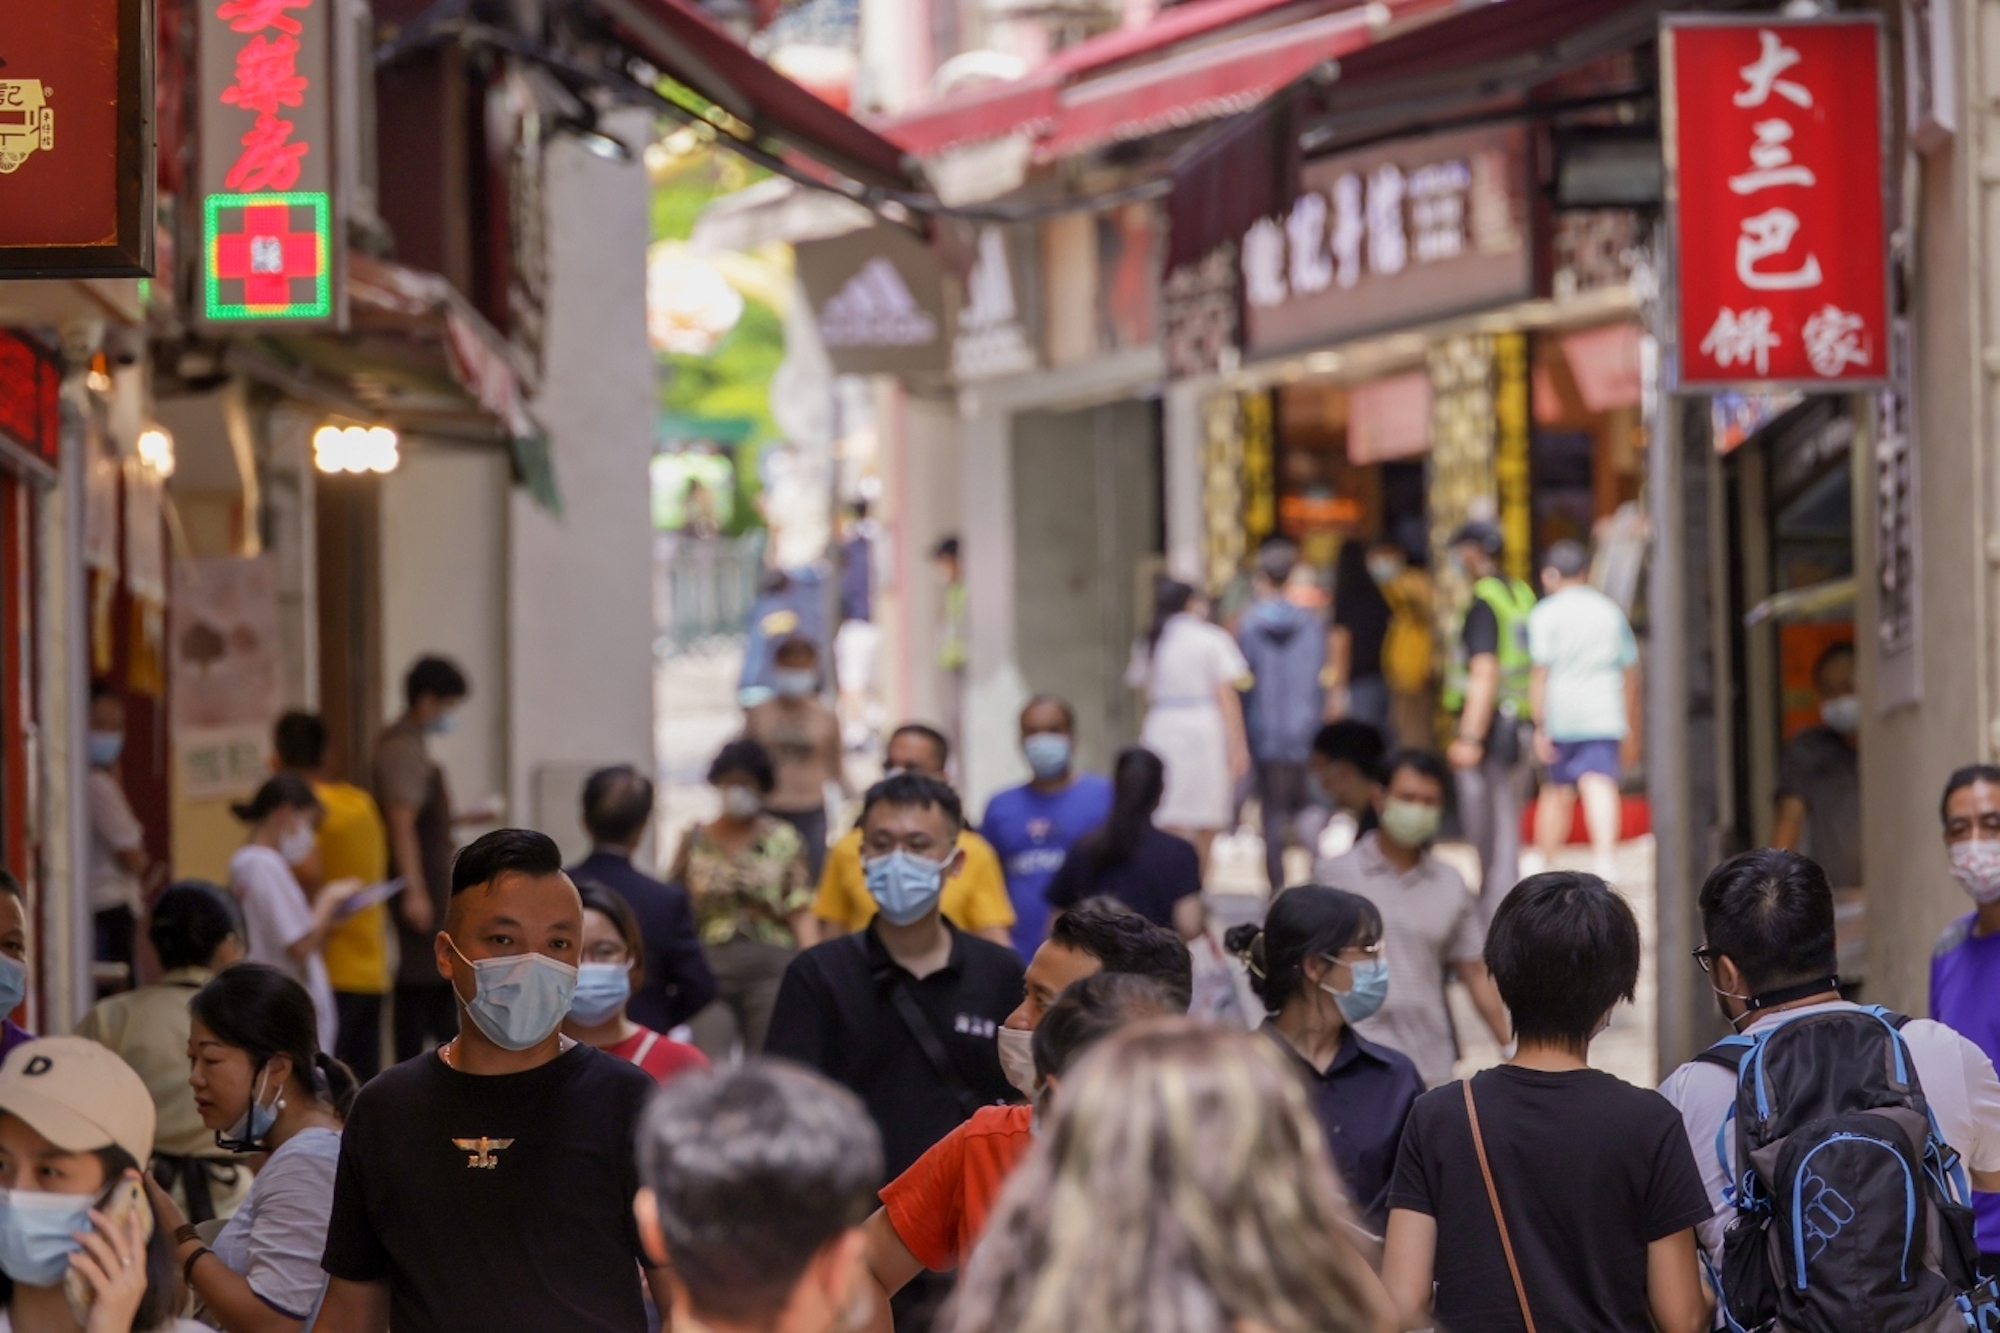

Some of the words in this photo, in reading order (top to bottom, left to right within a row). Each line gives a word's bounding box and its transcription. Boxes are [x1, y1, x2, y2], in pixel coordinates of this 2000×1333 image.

[1728, 28, 1823, 290] 大三巴
[22, 1055, 53, 1076] D
